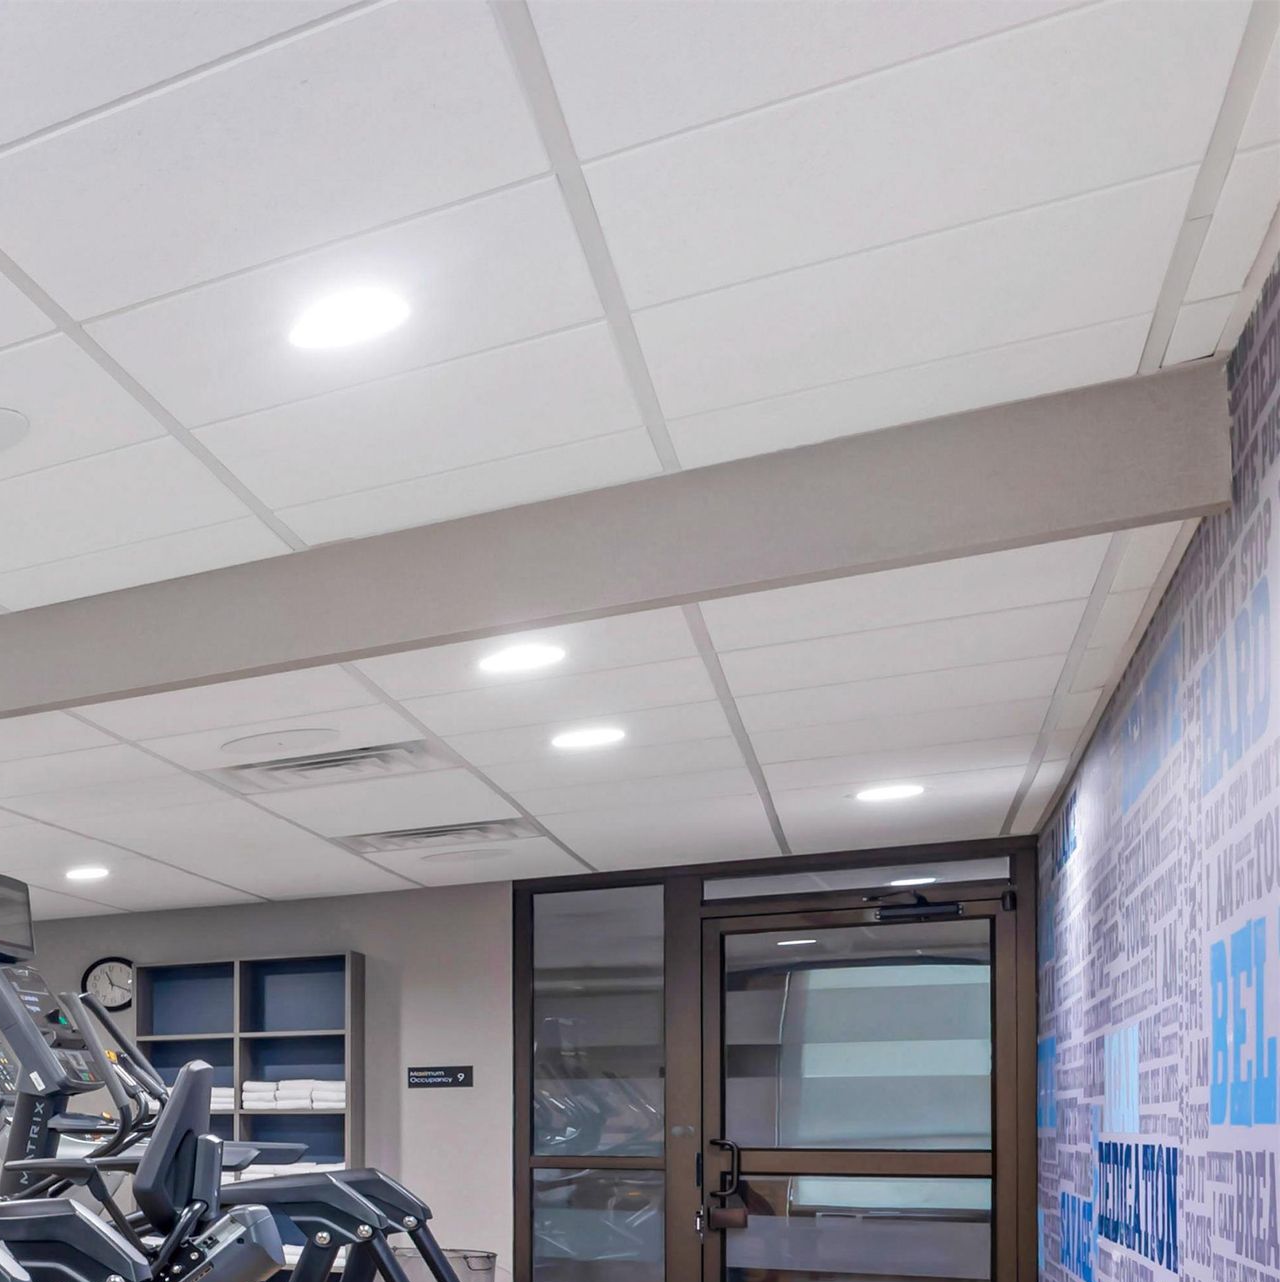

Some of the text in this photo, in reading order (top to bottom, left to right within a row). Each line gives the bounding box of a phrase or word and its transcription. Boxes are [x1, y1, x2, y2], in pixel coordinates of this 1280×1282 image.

[457, 1073, 465, 1082] 9
[19, 1101, 45, 1185] MTRIX
[1098, 1140, 1178, 1274] DEDICATION
